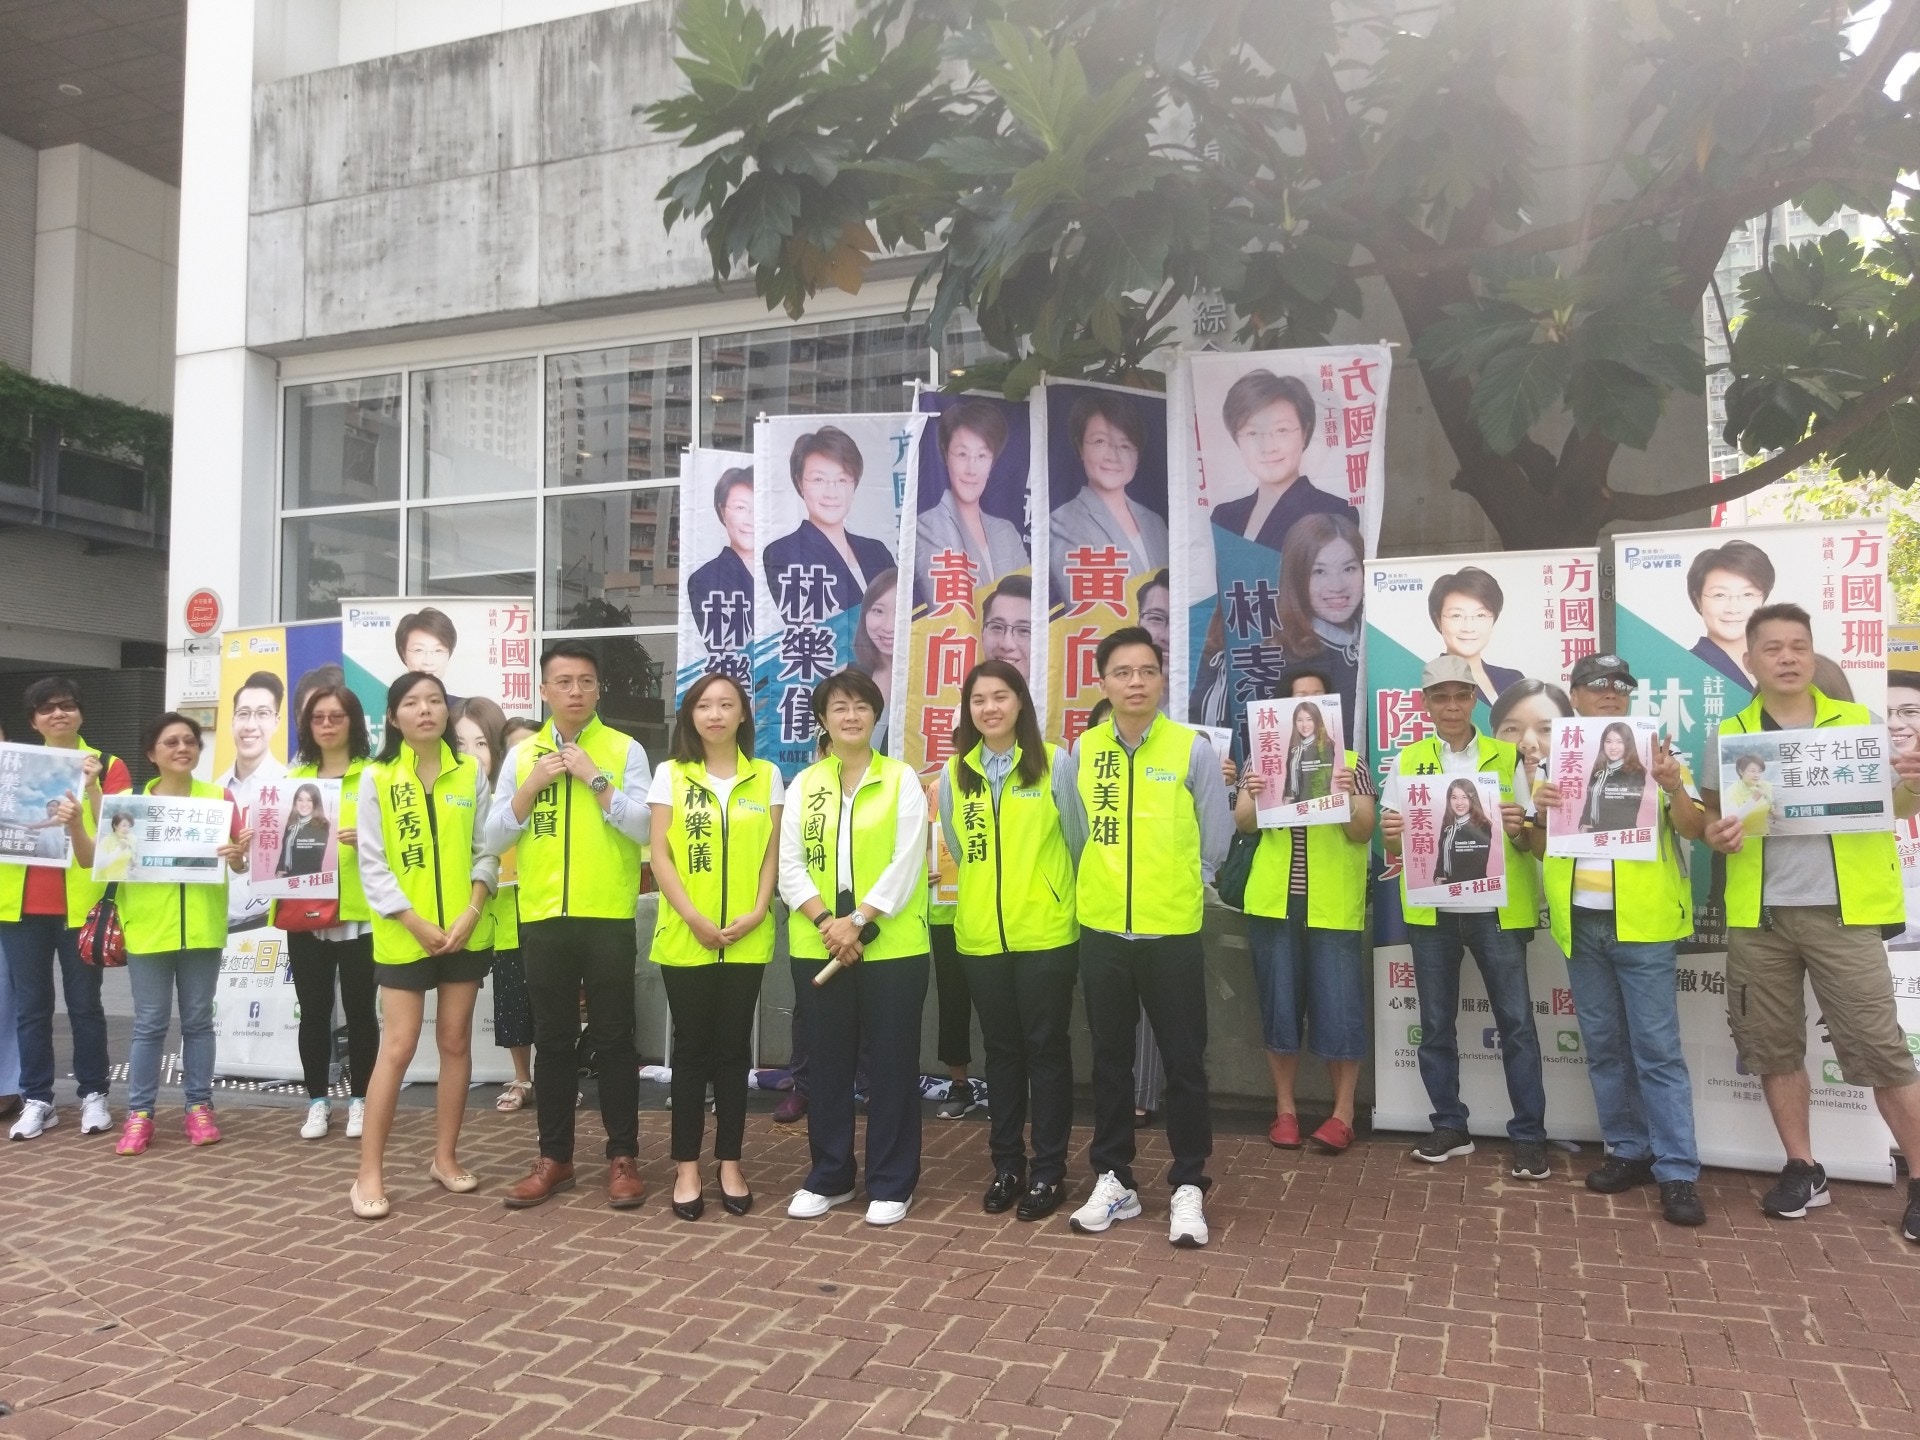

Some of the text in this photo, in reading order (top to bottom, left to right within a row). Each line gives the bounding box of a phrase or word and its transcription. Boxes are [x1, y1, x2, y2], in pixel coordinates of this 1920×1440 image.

[1559, 559, 1596, 668] 方國珊
[1841, 530, 1883, 657] 方國珊
[502, 605, 531, 700] 方國珊
[778, 565, 838, 744] 林樂儀
[1841, 660, 1885, 669] Christine
[502, 702, 533, 710] Christine
[1256, 708, 1282, 776] 林素蔚
[1559, 726, 1585, 800] 林素蔚
[1779, 738, 1881, 764] 堅守社區
[1092, 751, 1121, 846] 張美雄
[1781, 764, 1882, 788] 重燃希望
[145, 826, 221, 843] 重燃希望
[147, 806, 225, 825] 堅守社區
[259, 786, 280, 850] 林素蔚
[391, 782, 426, 875] 陸秀貞
[684, 785, 713, 875] 林樂儀
[804, 787, 833, 873] 方國珊
[1407, 783, 1435, 855] 林素蔚
[1394, 1049, 1416, 1057] 6750
[1394, 1060, 1416, 1068] 6398
[1458, 1052, 1503, 1061] christinefk
[1543, 1056, 1589, 1065] fksoffice32
[1810, 1087, 1865, 1099] ksoffice328
